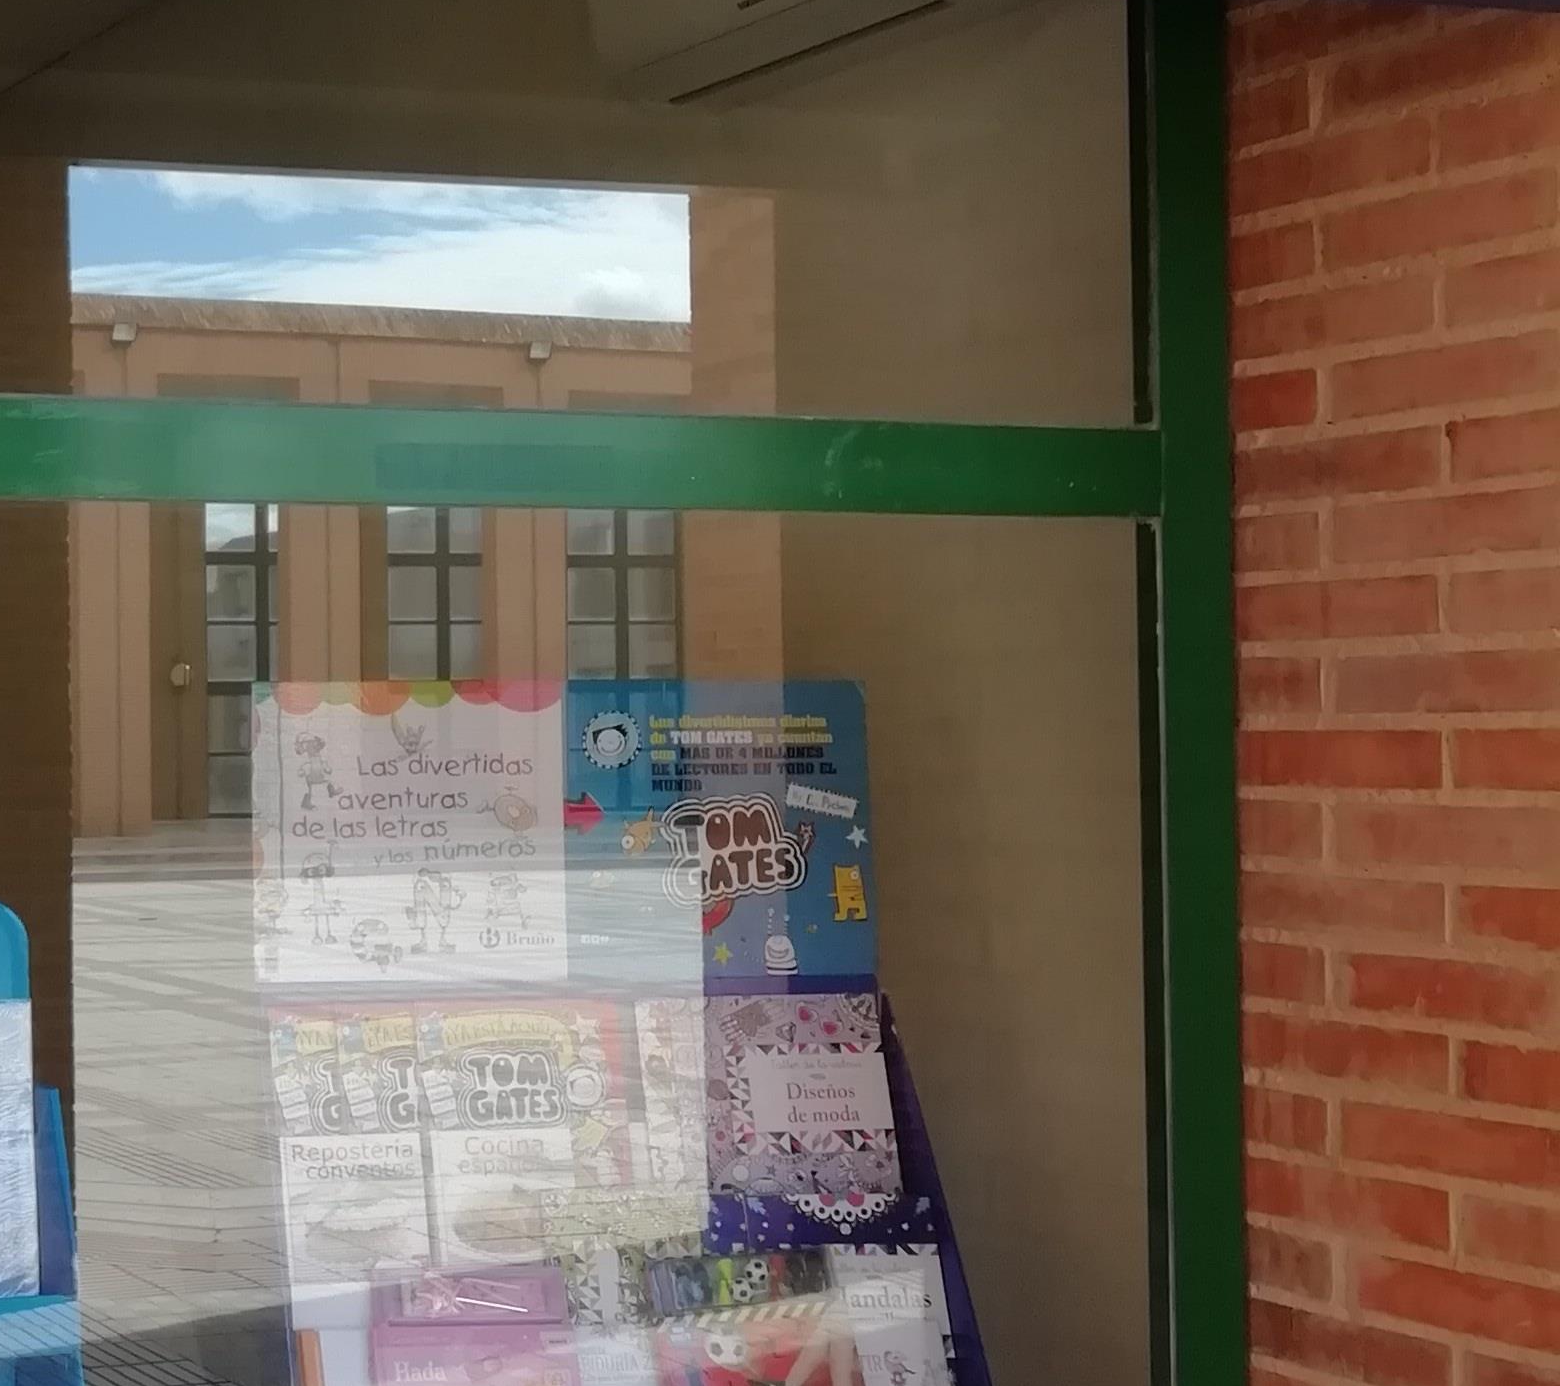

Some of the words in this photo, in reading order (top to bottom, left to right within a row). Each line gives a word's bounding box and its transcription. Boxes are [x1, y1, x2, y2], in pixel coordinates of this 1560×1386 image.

[670, 730, 703, 745] TOM
[706, 730, 754, 745] GATES
[357, 755, 399, 777] Las
[408, 753, 534, 777] divertidas
[674, 762, 748, 776] LECTORES
[819, 761, 838, 775] EL
[652, 778, 703, 793] MUNDO
[338, 786, 469, 811] aventuras
[292, 816, 326, 838] de
[332, 816, 367, 838] las
[376, 816, 449, 838] letras
[672, 808, 773, 857] TOM
[424, 838, 537, 861] números
[671, 847, 798, 901] GATES
[467, 1055, 549, 1088] TOM
[786, 1081, 856, 1100] Diseños
[468, 1088, 559, 1124] GATES
[787, 1104, 807, 1123] de
[811, 1103, 860, 1123] moda
[291, 1139, 414, 1164] Repostería
[464, 1135, 545, 1157] Cocina
[394, 1360, 448, 1383] Hada
